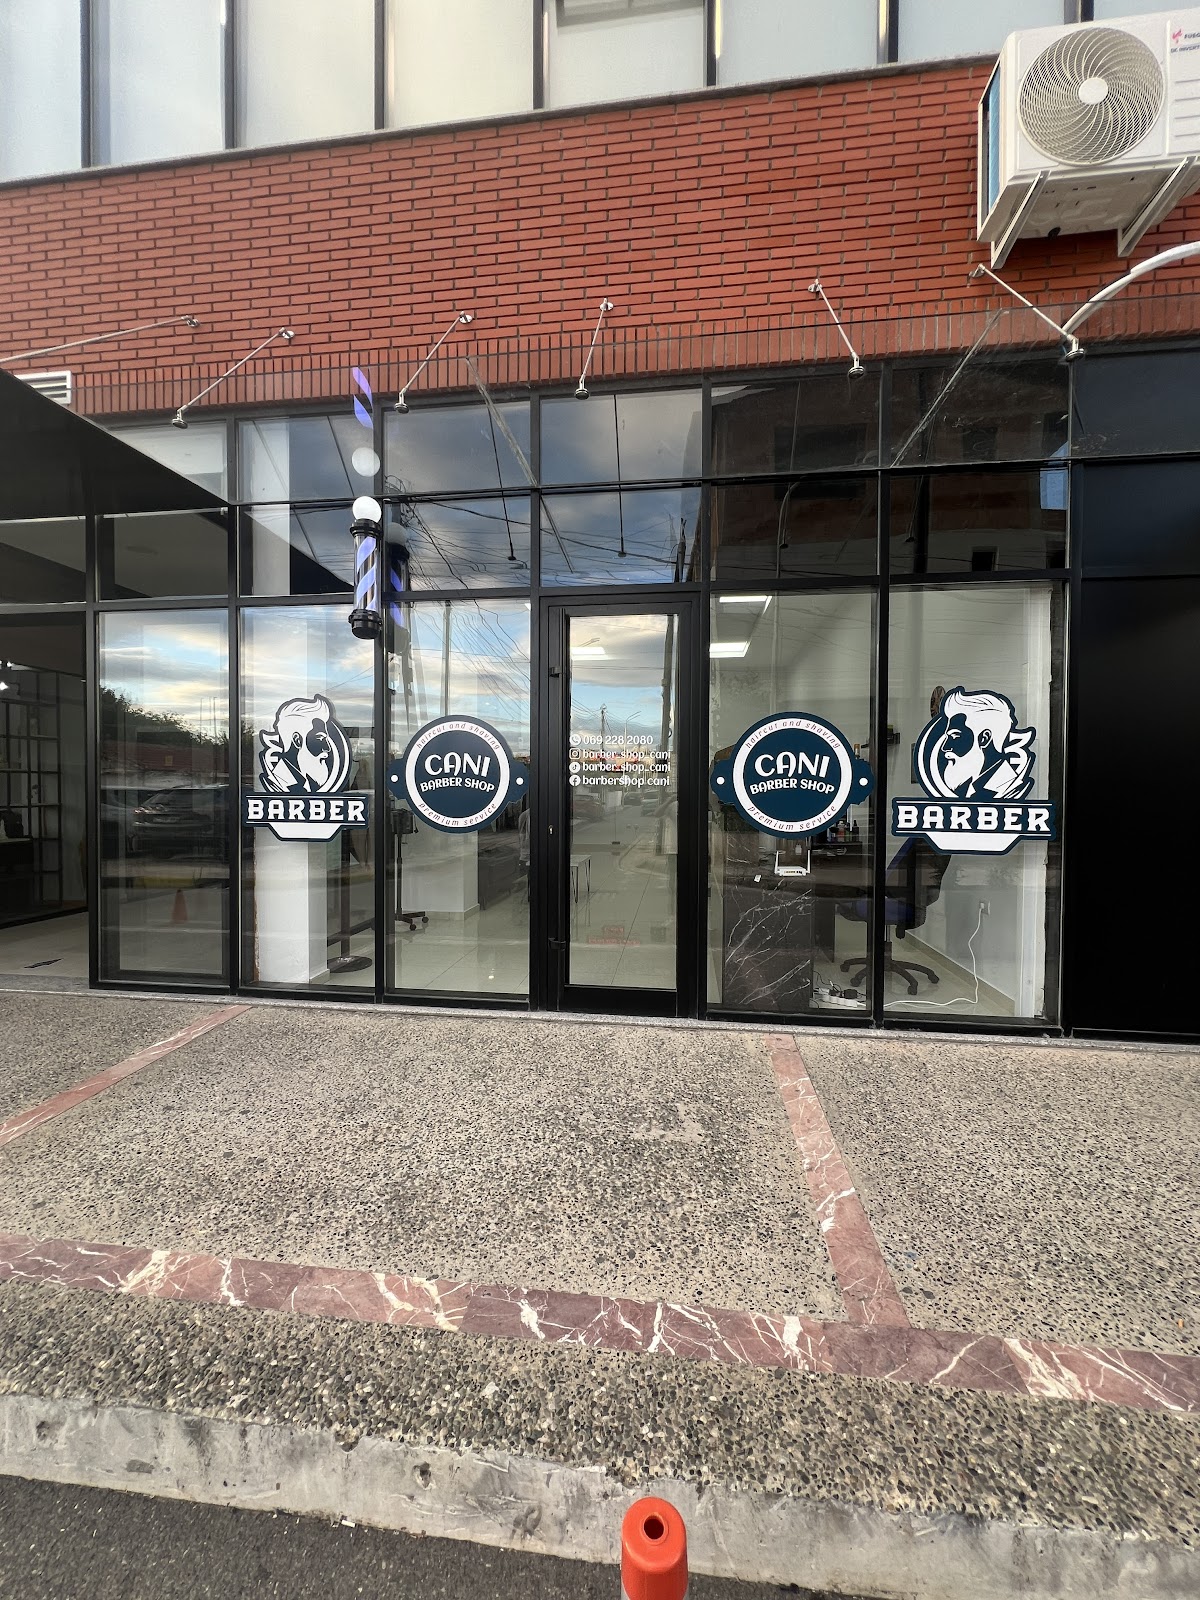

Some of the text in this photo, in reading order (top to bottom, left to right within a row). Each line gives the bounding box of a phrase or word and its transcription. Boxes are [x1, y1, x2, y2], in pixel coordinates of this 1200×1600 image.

[416, 722, 500, 750] haircut and shaving
[583, 735, 654, 745] 069 228 2080
[745, 719, 841, 750] haircut and shaving
[424, 751, 491, 778] CANI
[754, 751, 831, 778] CANI
[420, 777, 495, 793] BARBER SHOP
[749, 778, 835, 795] BARBER SHOP
[247, 799, 366, 821] BARBER
[418, 803, 497, 826] premium service
[747, 805, 837, 831] premium service
[896, 805, 1051, 832] BARBER
